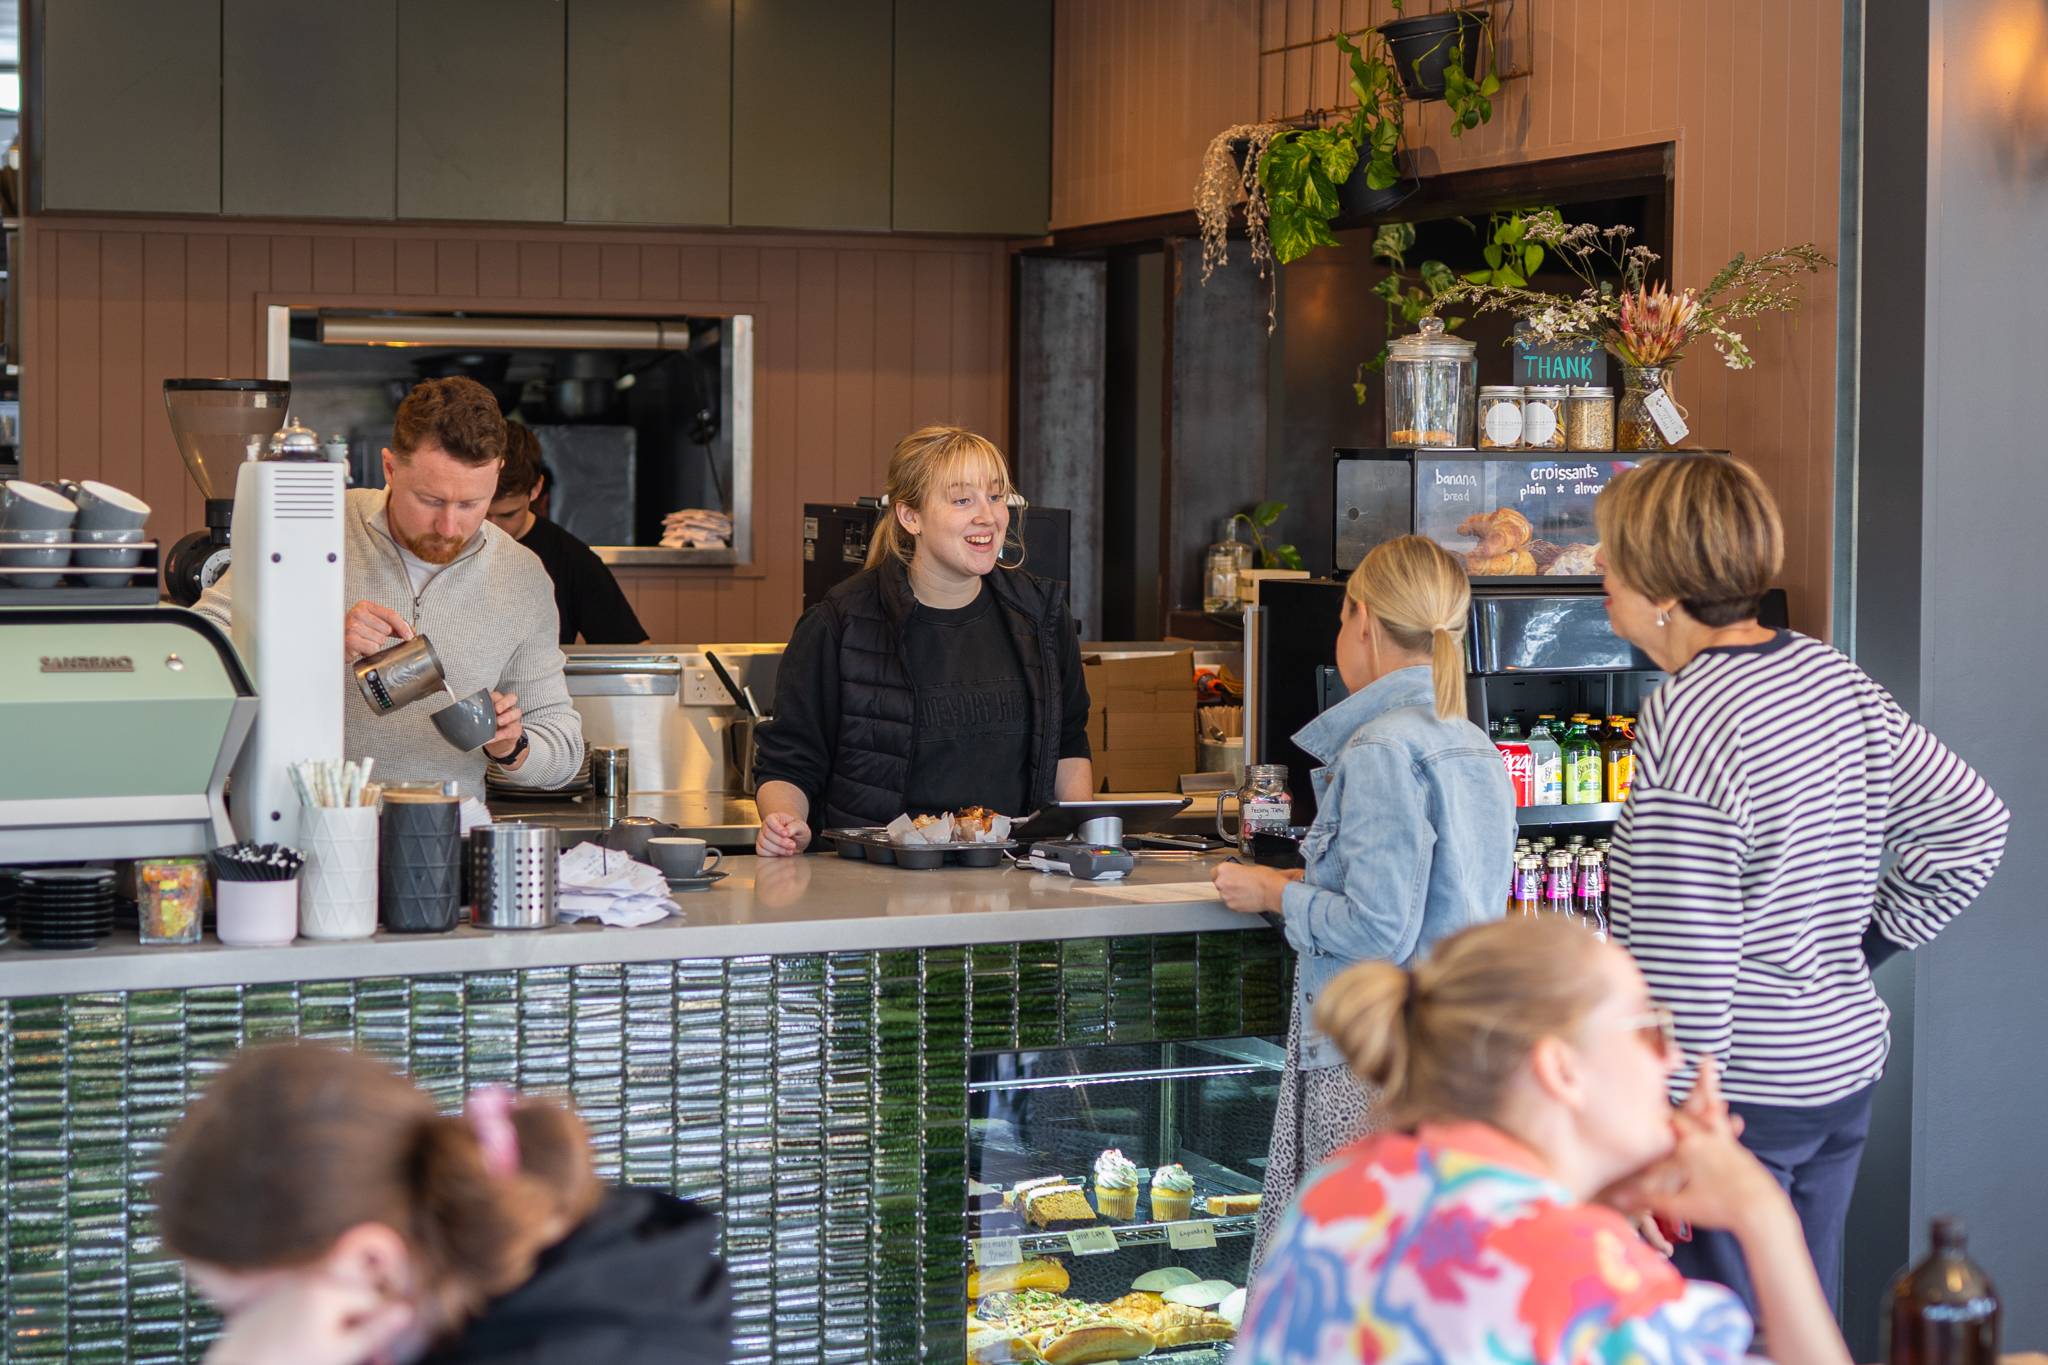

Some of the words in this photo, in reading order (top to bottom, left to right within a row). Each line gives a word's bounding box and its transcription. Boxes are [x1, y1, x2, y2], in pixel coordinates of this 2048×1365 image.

[1523, 355, 1593, 380] THANK
[1435, 468, 1477, 487] banana
[1530, 463, 1599, 481] croissants
[1443, 488, 1470, 502] bread
[1519, 483, 1547, 502] plain
[40, 655, 134, 672] SANREMO
[918, 692, 992, 731] OUNTRY
